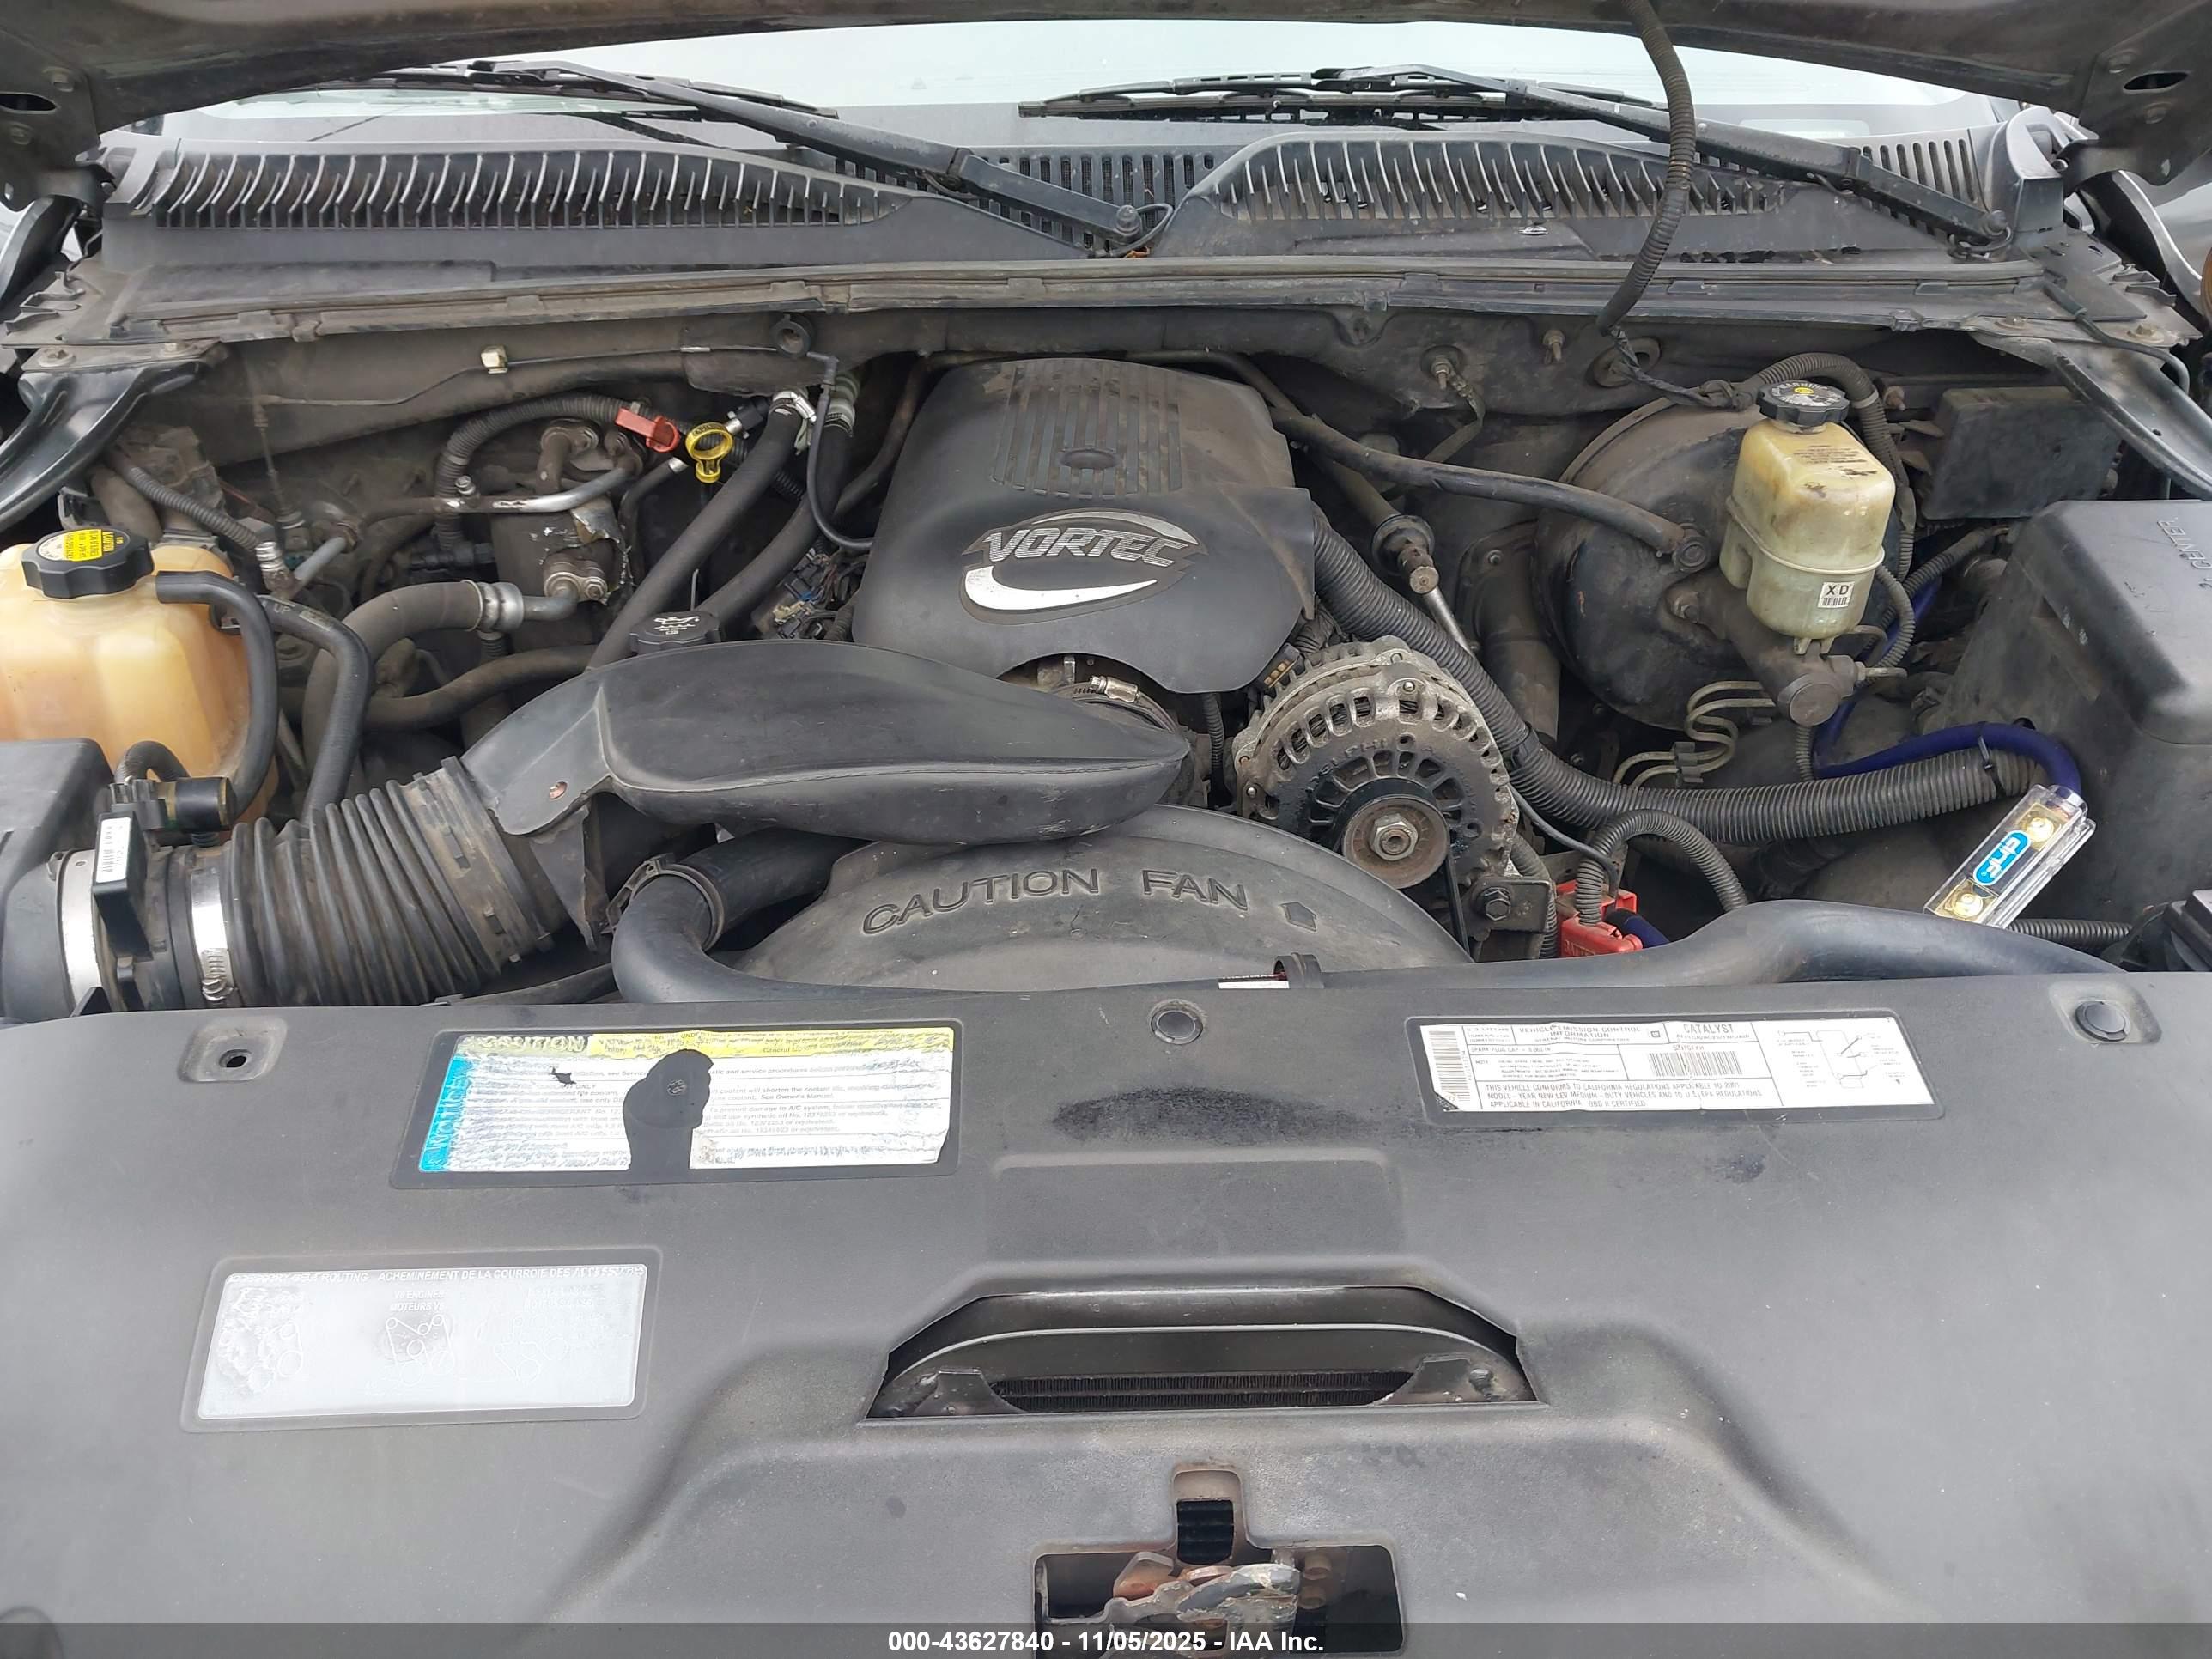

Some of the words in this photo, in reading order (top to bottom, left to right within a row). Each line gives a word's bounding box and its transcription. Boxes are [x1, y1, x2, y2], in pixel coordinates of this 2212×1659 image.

[982, 527, 1189, 567] VORTEC
[862, 868, 1100, 934] CAUTION
[1141, 869, 1249, 912] FAN
[1683, 1024, 1734, 1034] CATALYST
[767, 1066, 808, 1075] procedures
[1673, 1082, 1711, 1091] APPLICABLE
[1611, 1099, 1646, 1108] CERTIFIED
[321, 1272, 370, 1283] ROUTING
[378, 1269, 459, 1281] ACHEMINEMENT
[461, 1269, 477, 1279] DE
[477, 1269, 492, 1279] LA
[493, 1267, 547, 1279] COURROIE
[549, 1267, 571, 1278] DES
[406, 1290, 445, 1299] ENGINES
[389, 1301, 432, 1311] MOTEURS
